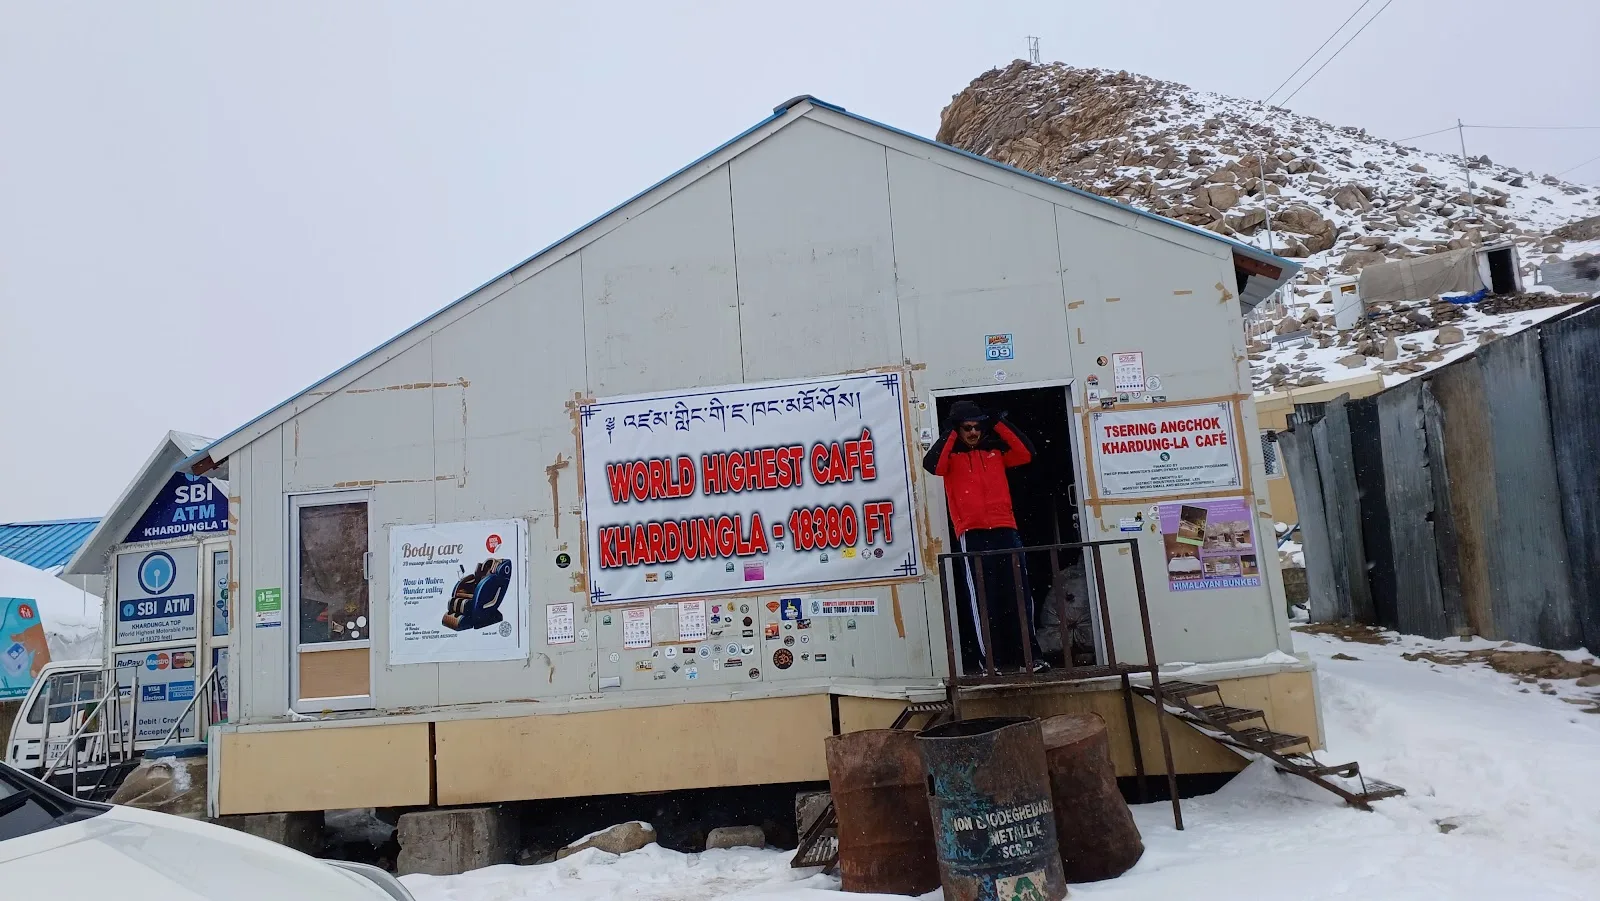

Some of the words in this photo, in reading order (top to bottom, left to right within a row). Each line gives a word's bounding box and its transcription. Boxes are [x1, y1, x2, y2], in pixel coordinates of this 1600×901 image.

[1104, 422, 1157, 438] TSERING
[1160, 417, 1221, 434] ANGCHOK
[1102, 436, 1189, 454] KHARDUNG-LA
[1195, 430, 1228, 448] CAFÉ
[606, 456, 696, 503] WORLD
[702, 446, 804, 494] HIGHEST
[811, 428, 877, 485] CAFÉ
[175, 483, 212, 504] SBI
[172, 504, 215, 522] ATM
[144, 521, 218, 537] KHARDUNGLA
[221, 520, 228, 528] T
[599, 512, 768, 569] KHARDUNGLA
[789, 504, 858, 551] 18380
[864, 501, 894, 545] FT
[401, 542, 435, 560] Body
[438, 543, 464, 556] care
[402, 578, 416, 586] Now
[418, 578, 424, 586] in
[425, 586, 444, 595] valley
[1172, 580, 1221, 591] HIMALAYAN
[1223, 578, 1258, 587] BUNKER
[137, 601, 158, 616] SBI
[164, 598, 190, 614] ATM
[118, 630, 135, 639] (World
[136, 628, 155, 637] Highest
[132, 621, 170, 630] KHARDUNGLA
[117, 659, 141, 668] RuPay
[147, 658, 169, 666] Maestro
[138, 728, 170, 736] Accepted
[990, 820, 1042, 846] METALLIC
